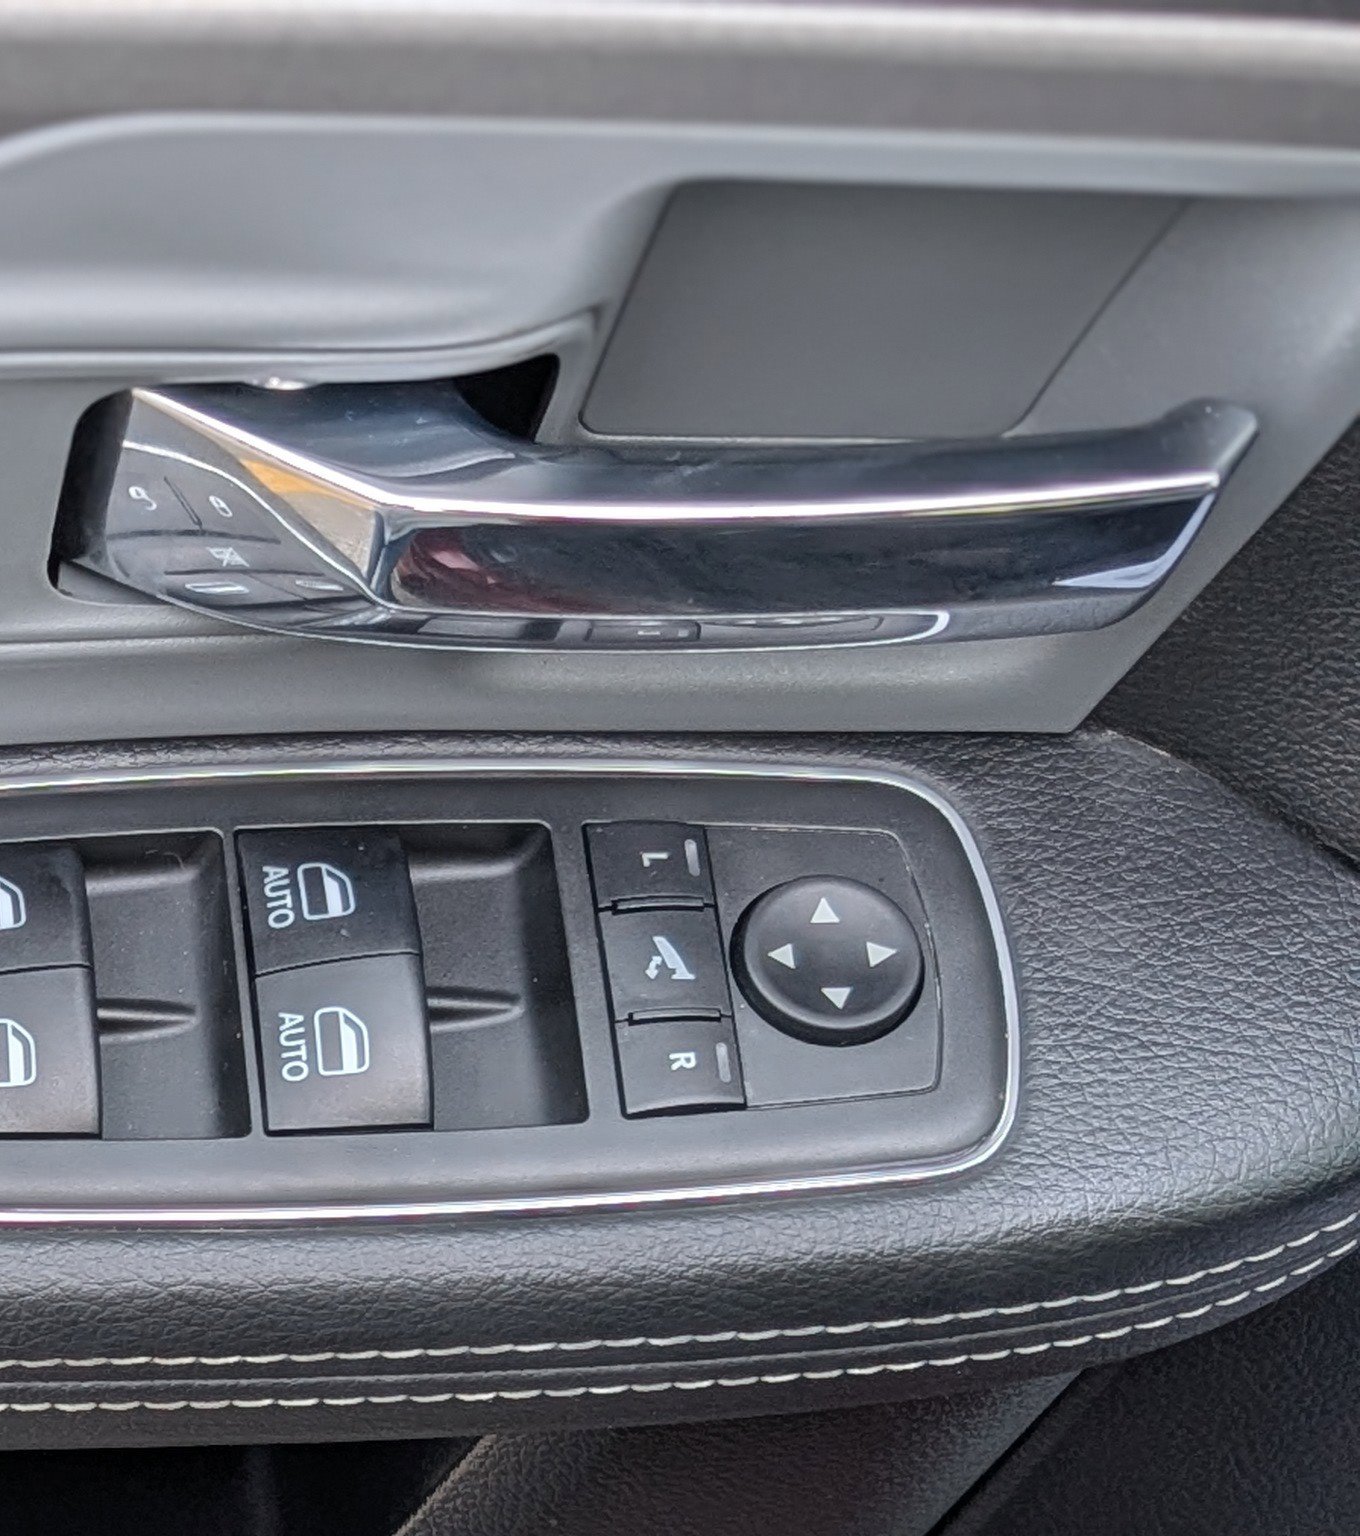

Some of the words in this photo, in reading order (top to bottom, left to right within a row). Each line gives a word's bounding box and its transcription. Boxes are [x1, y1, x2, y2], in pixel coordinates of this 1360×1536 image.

[641, 852, 669, 868] L
[262, 865, 295, 929] AUTO
[278, 1012, 309, 1082] AUTO
[668, 1051, 697, 1071] R
